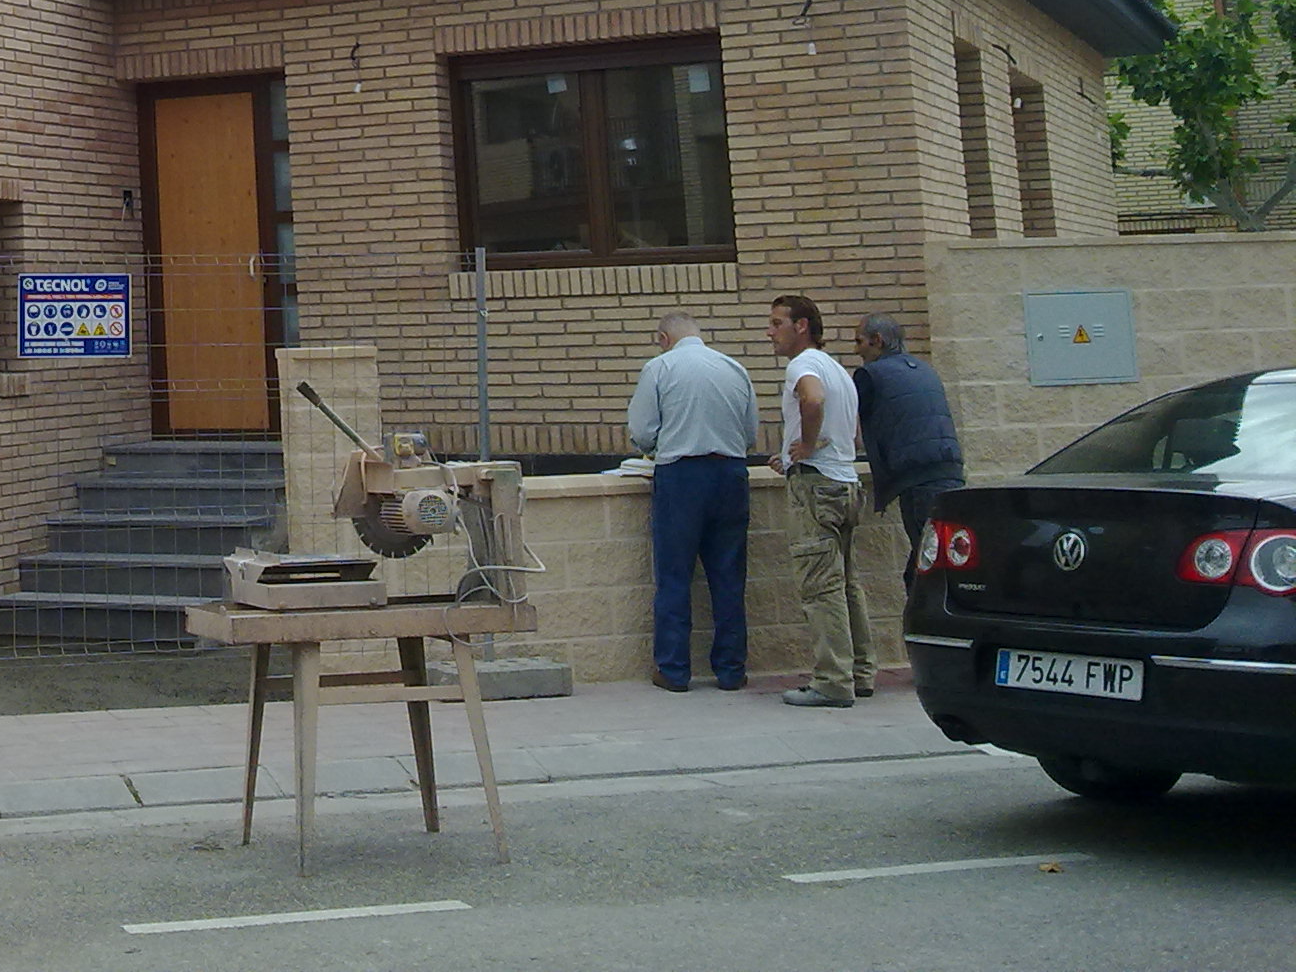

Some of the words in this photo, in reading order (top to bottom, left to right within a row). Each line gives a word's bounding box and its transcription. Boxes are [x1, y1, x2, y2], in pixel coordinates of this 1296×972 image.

[35, 279, 89, 291] TECNOL
[1015, 654, 1074, 687] 7544
[1085, 661, 1134, 694] FWP
